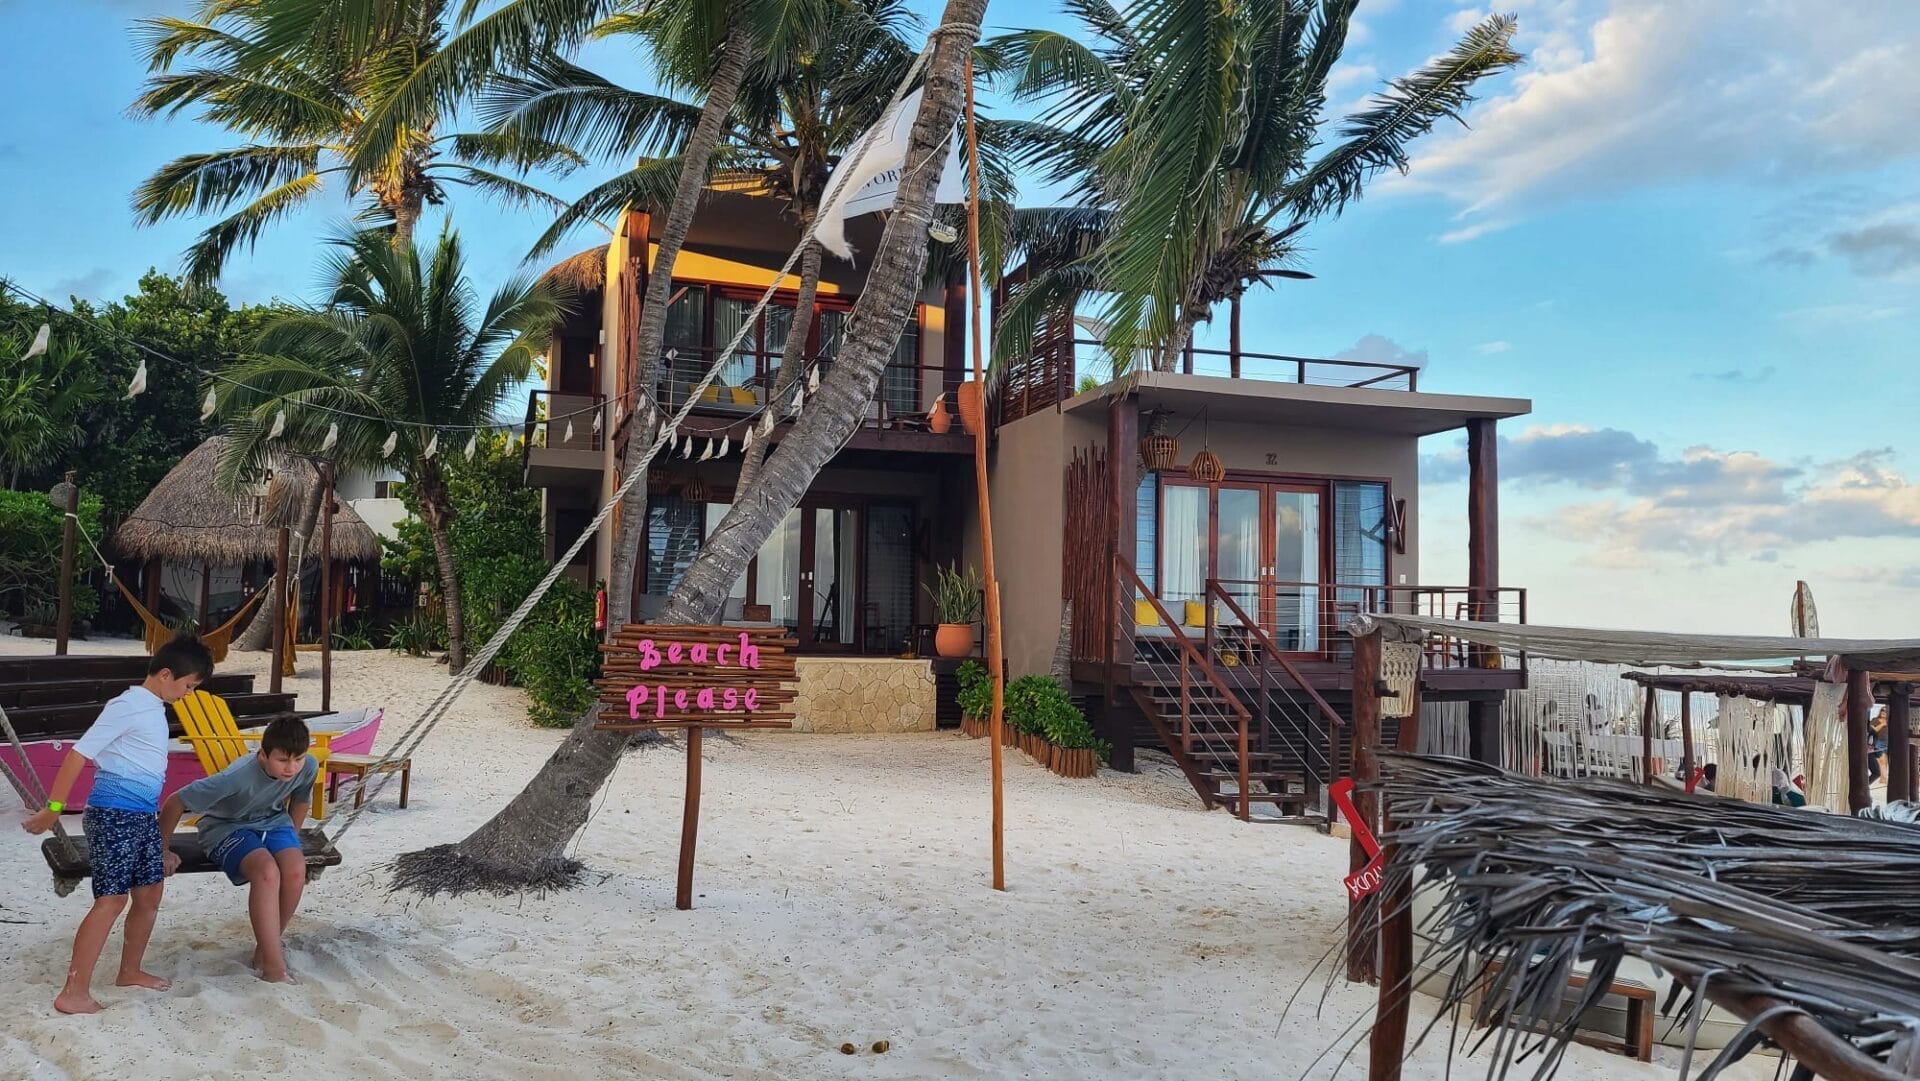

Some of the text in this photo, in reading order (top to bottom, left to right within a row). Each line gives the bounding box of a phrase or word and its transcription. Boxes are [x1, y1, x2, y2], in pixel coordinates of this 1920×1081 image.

[1265, 453, 1278, 465] 32
[638, 632, 760, 671] Beach
[626, 685, 761, 719] Please
